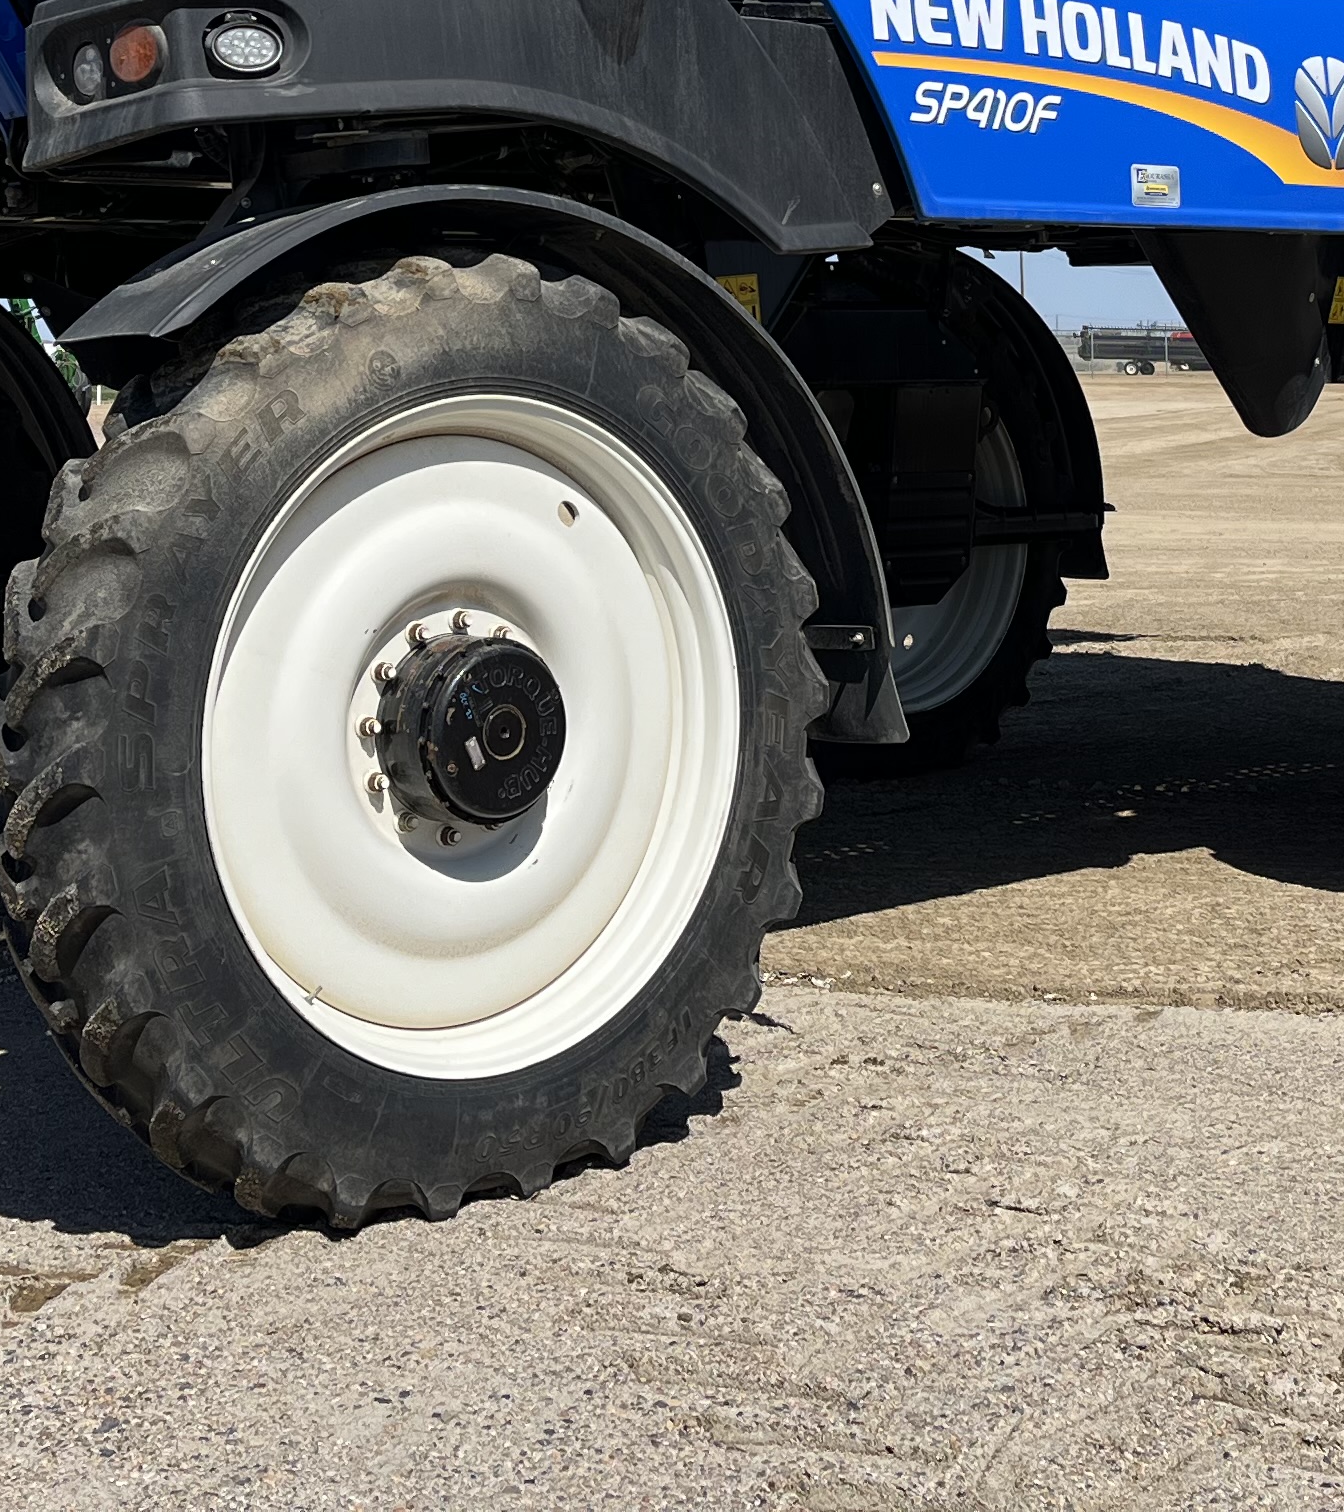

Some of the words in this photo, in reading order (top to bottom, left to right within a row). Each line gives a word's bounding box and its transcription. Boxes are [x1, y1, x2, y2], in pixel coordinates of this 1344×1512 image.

[909, 80, 1063, 135] SP410F
[118, 388, 307, 793] SPRAYER
[636, 384, 792, 904] GOODYEAR
[132, 862, 301, 1124] ULTRA
